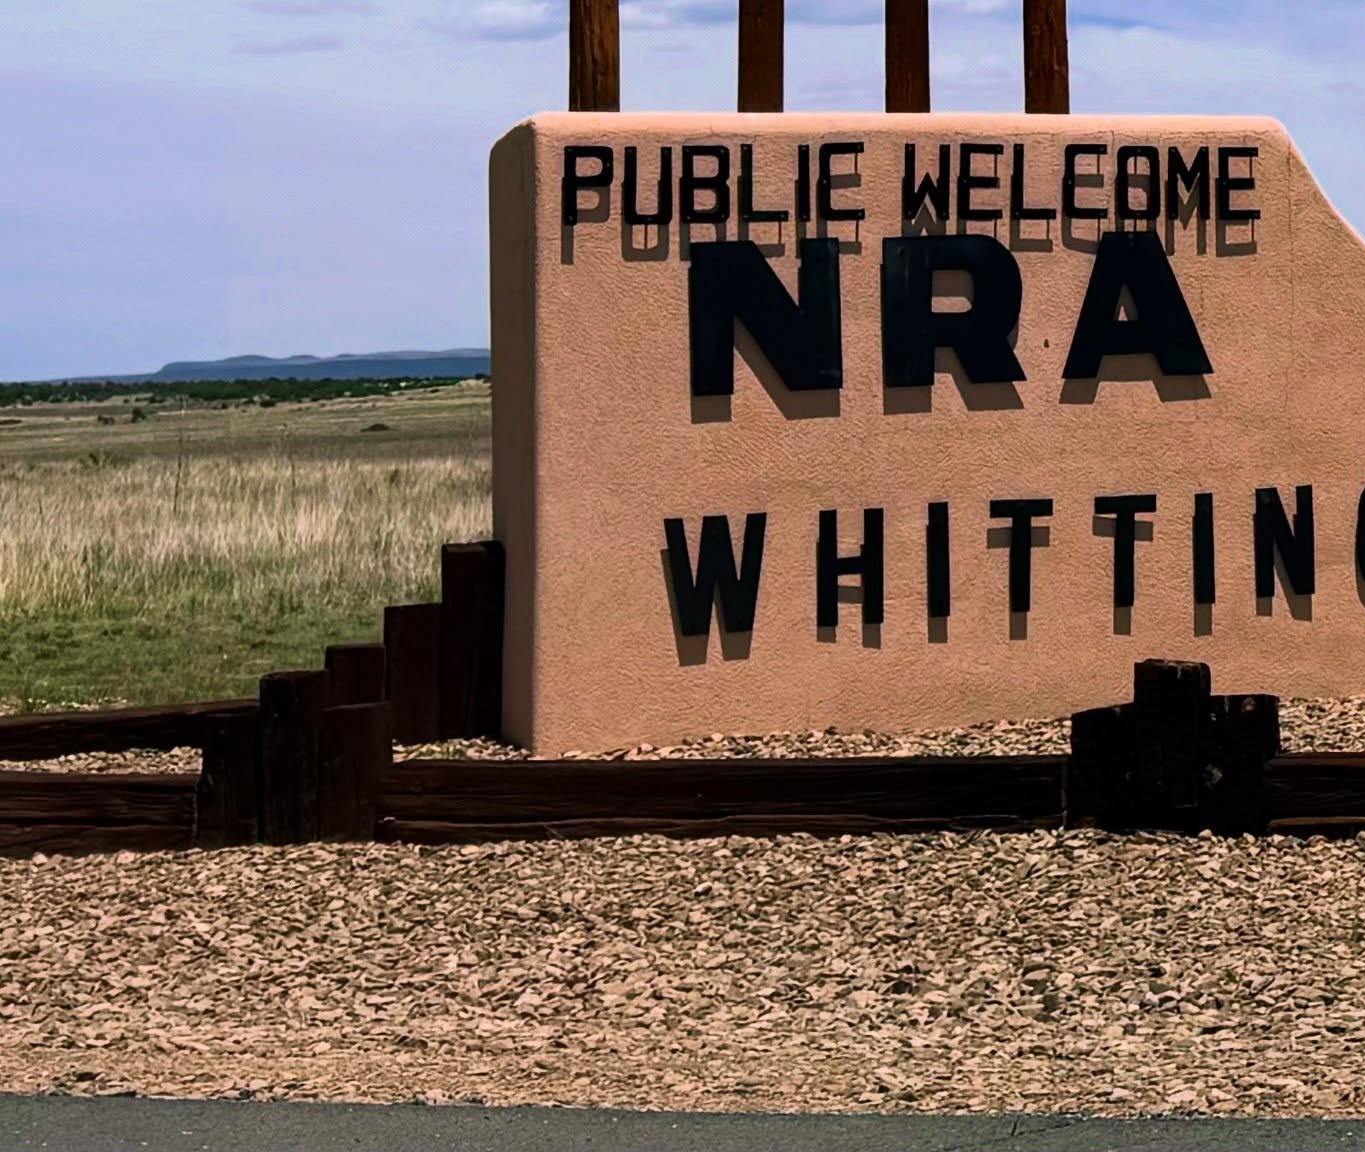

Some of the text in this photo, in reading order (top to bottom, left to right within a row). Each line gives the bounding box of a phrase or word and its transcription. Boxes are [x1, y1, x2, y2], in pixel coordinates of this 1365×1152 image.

[564, 142, 1261, 226] PUBLIC WELCOME
[691, 231, 1214, 396] NRA
